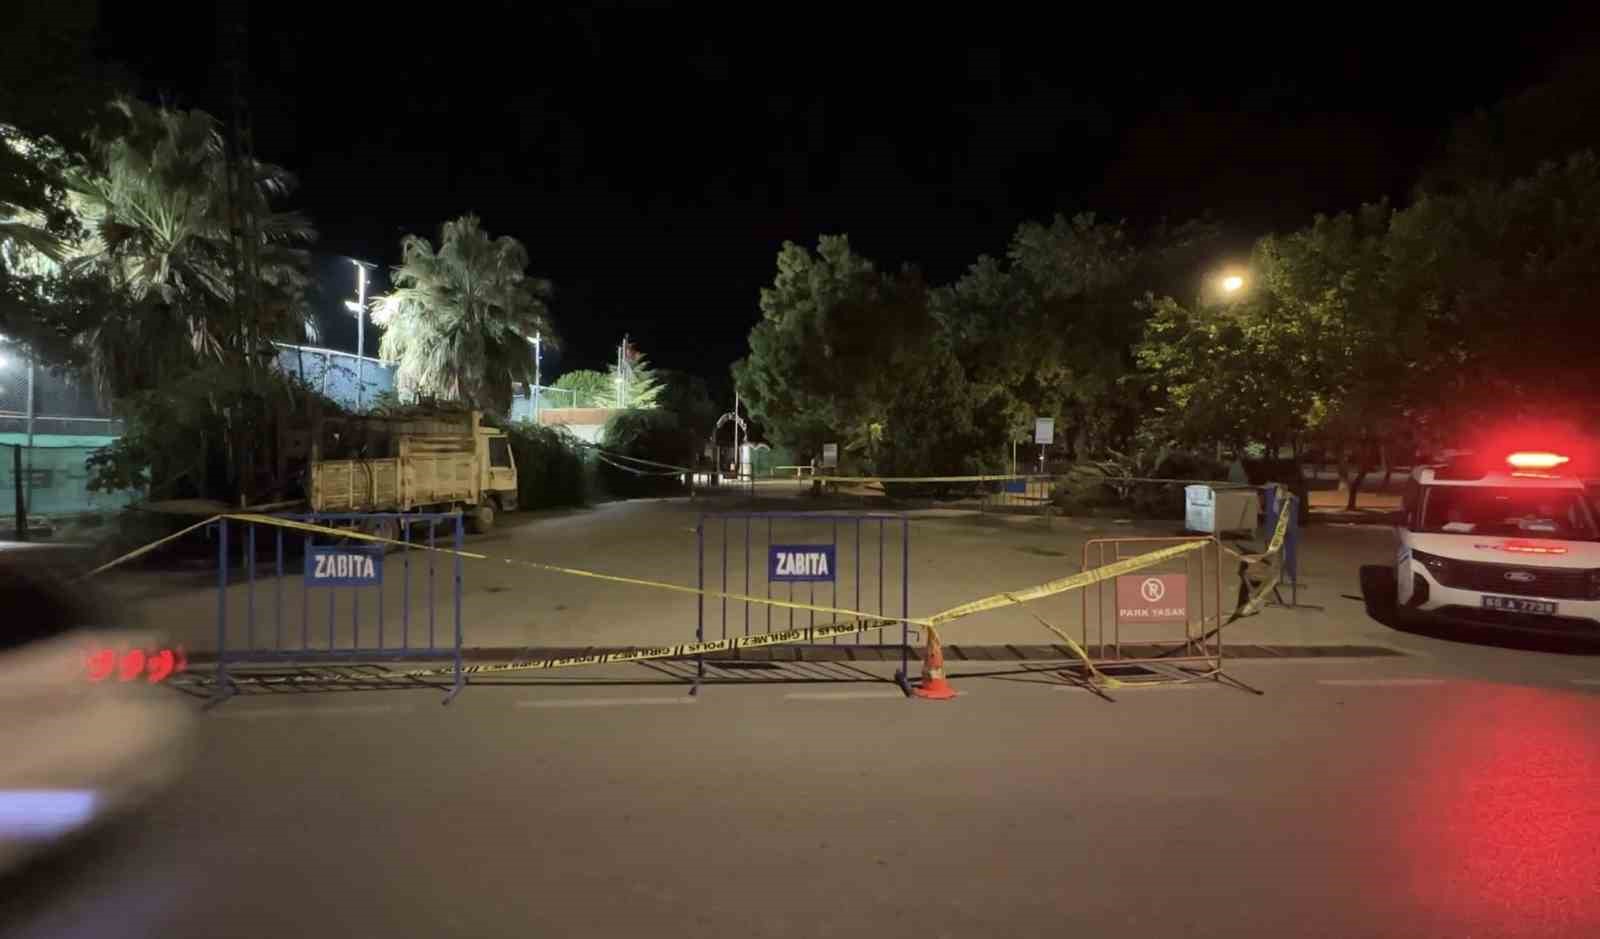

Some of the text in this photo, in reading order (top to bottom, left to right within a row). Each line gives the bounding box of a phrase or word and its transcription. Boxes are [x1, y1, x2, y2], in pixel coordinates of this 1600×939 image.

[315, 554, 375, 578] ZABITA
[776, 552, 829, 576] ZABITA
[1120, 608, 1185, 617] PARK YASAK
